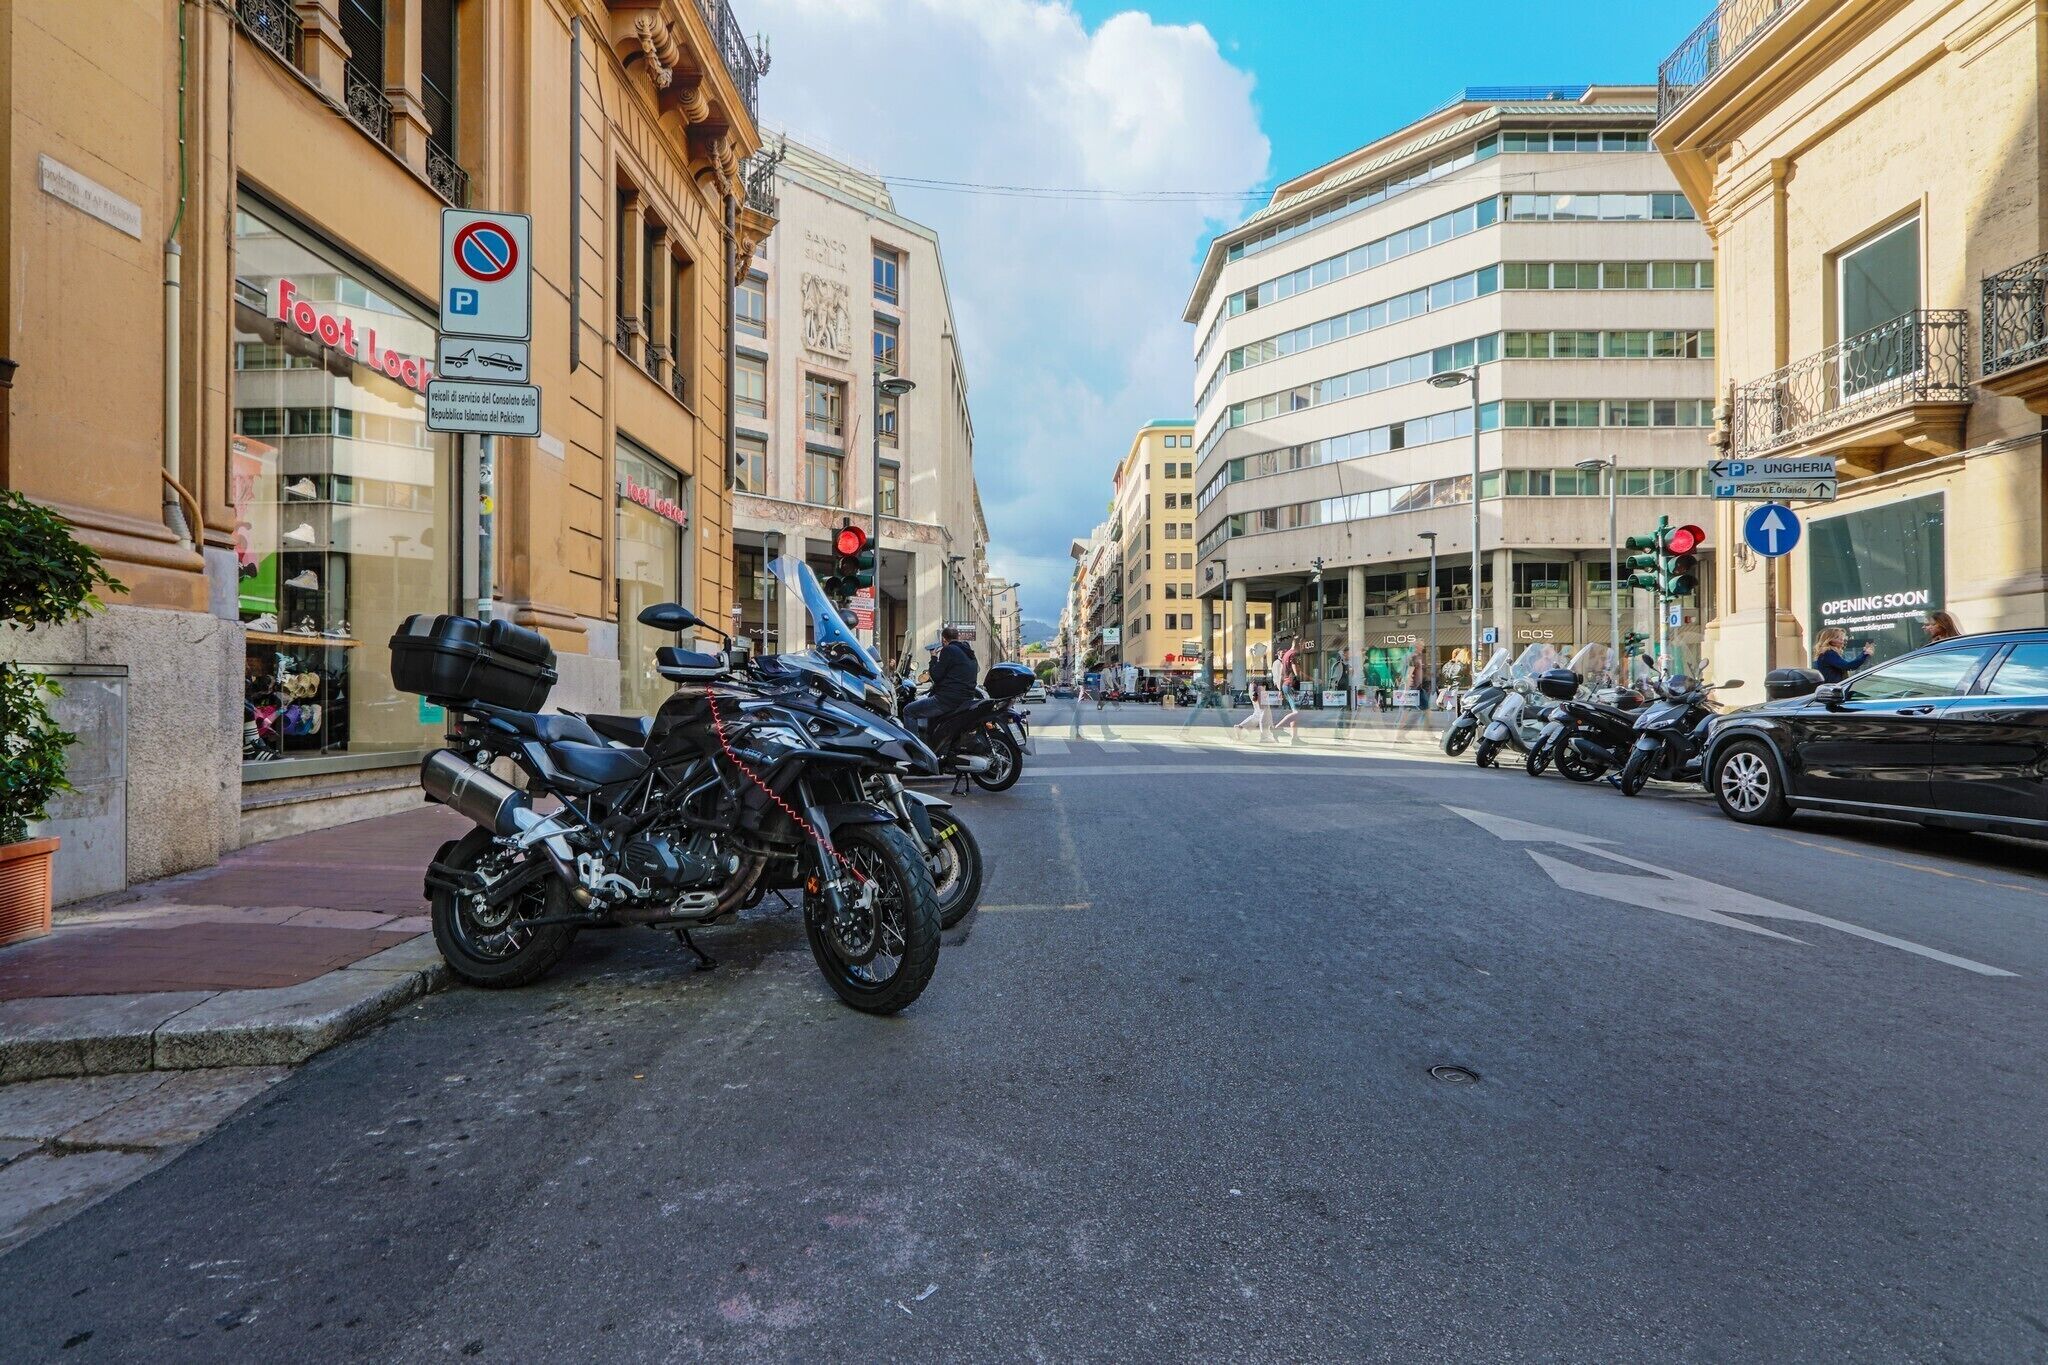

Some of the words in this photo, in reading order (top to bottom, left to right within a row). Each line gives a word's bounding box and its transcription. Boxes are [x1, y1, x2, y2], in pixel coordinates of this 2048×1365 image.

[805, 227, 847, 254] BANCO
[805, 248, 847, 274] SICILIA
[456, 291, 473, 311] P
[279, 277, 357, 358] Foot
[368, 327, 434, 393] Lock
[431, 389, 449, 402] veicoli
[451, 390, 457, 402] di
[458, 391, 480, 403] servizio
[482, 392, 491, 404] del
[493, 393, 520, 406] Consolato
[521, 394, 536, 406] della
[431, 407, 463, 422] Repubblica
[464, 409, 488, 421] Islamica
[490, 410, 499, 422] del
[500, 411, 525, 424] Pakistan
[1746, 464, 1757, 474] P.
[1764, 462, 1833, 474] UNGHERIA
[1736, 485, 1760, 494] Piazza
[626, 474, 650, 507] Foot
[654, 490, 687, 527] Locker
[1821, 595, 1882, 615] OPENING
[1884, 589, 1928, 608] SOON
[1824, 618, 1836, 626] Fino
[1836, 617, 1847, 625] alla
[1847, 615, 1875, 624] riapertura
[1881, 612, 1904, 620] trovate
[1904, 610, 1925, 618] online
[1384, 634, 1417, 645] IQOS
[1517, 629, 1554, 640] IQOS
